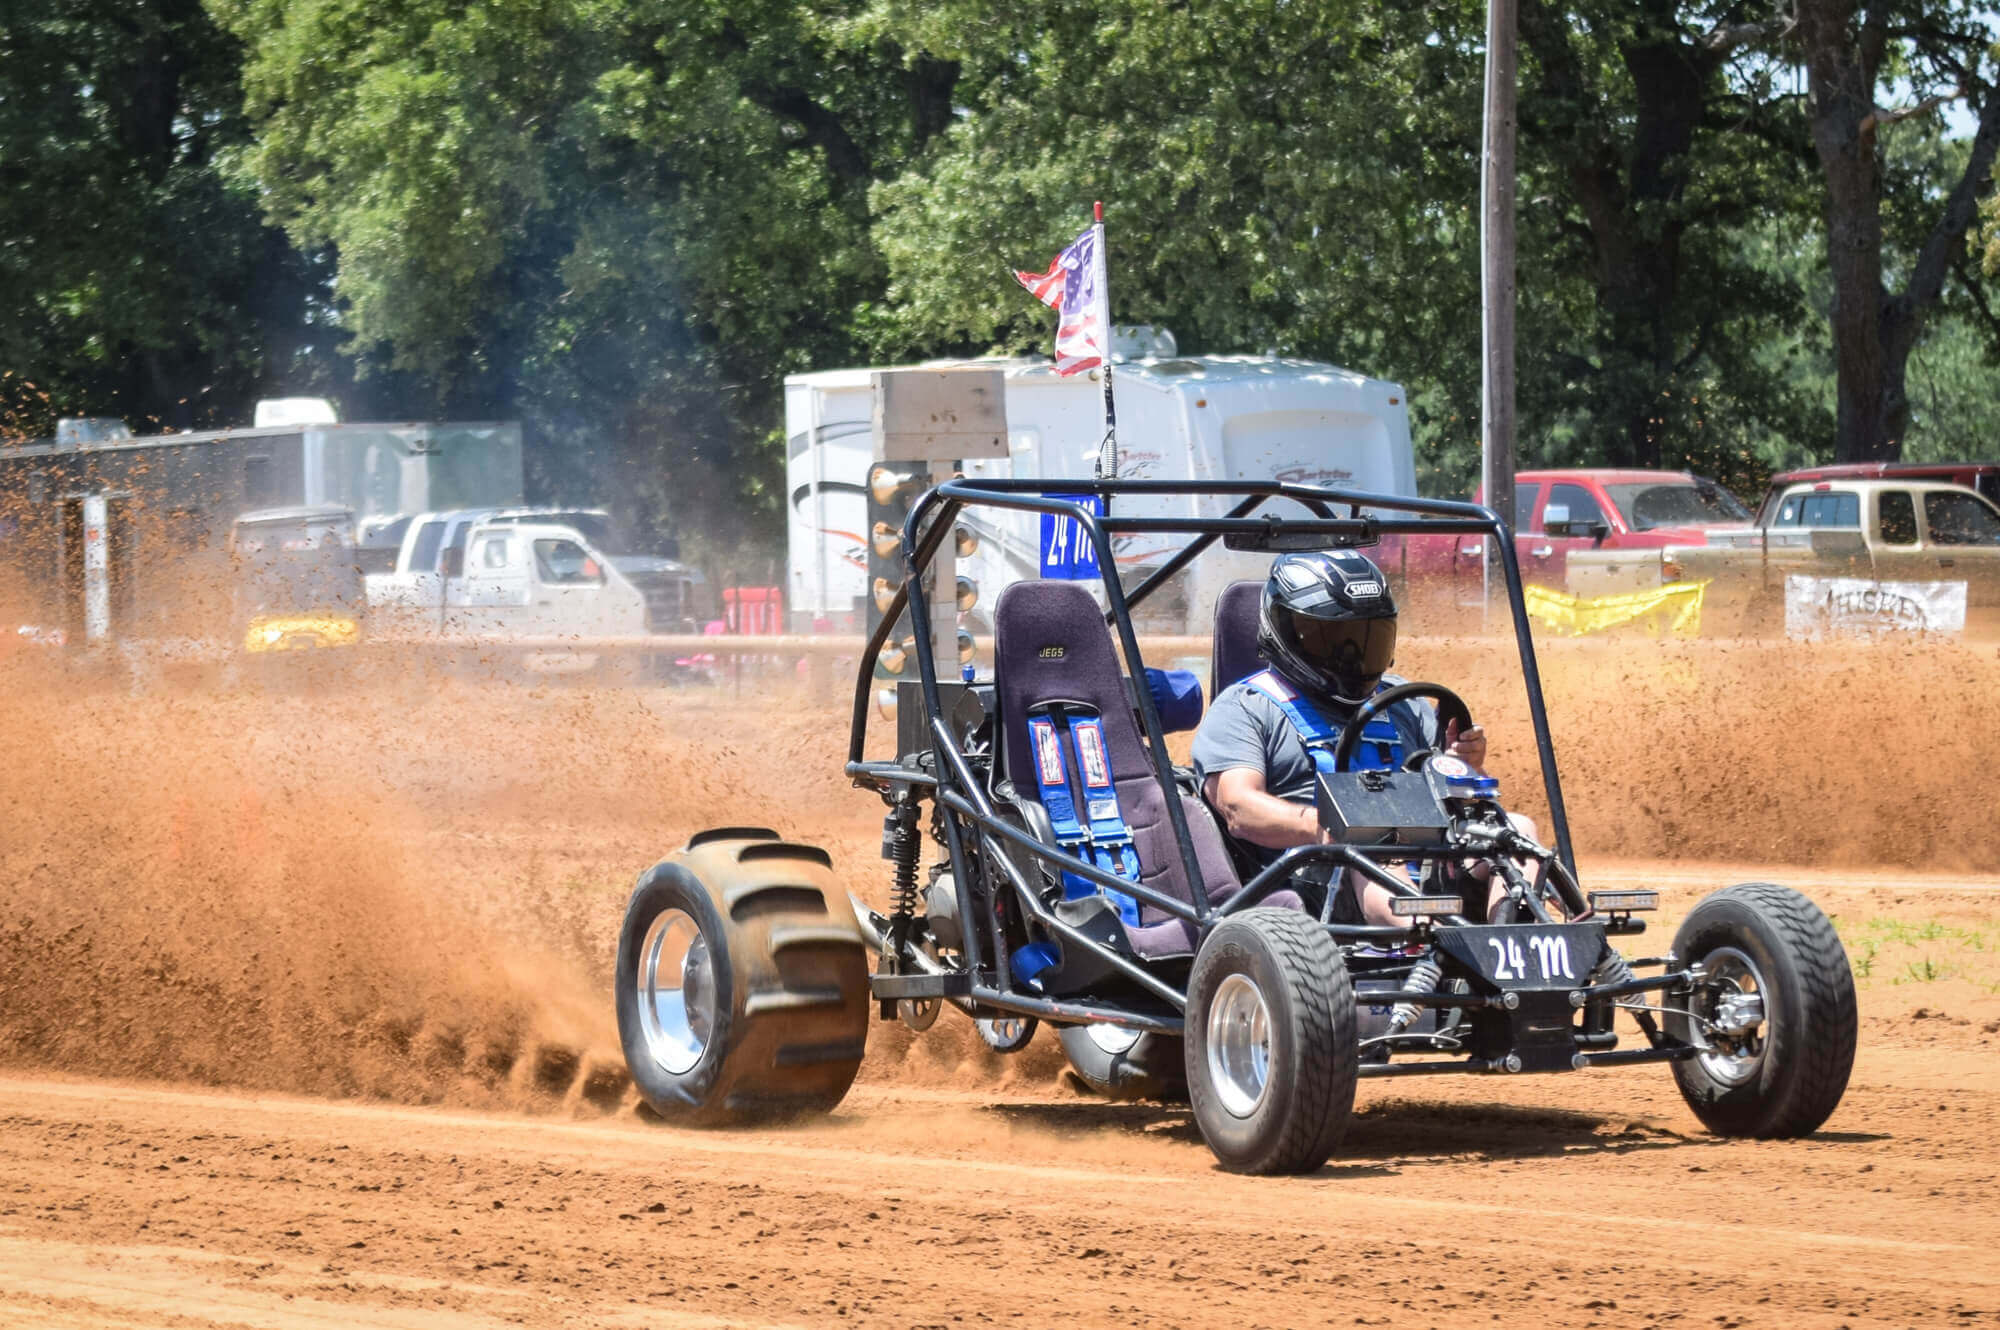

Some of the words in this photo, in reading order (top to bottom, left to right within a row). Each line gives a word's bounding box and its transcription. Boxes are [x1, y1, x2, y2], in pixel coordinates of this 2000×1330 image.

[1047, 509, 1069, 566] 24
[1039, 647, 1064, 658] JEGS
[1488, 936, 1526, 980] 24
[1529, 935, 1575, 980] M
